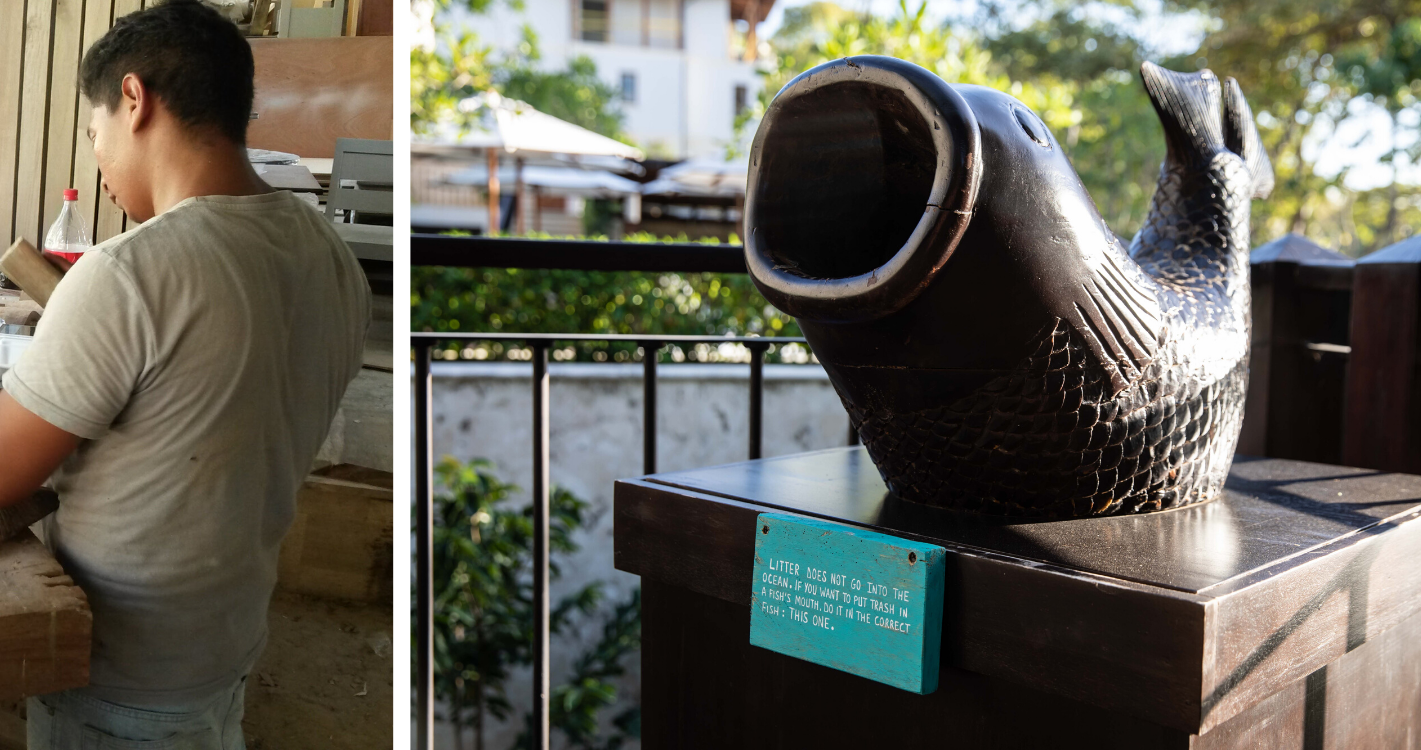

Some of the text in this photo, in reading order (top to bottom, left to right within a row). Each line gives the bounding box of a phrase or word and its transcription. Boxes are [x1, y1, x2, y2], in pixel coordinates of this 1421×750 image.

[762, 572, 908, 618] OCEAN. IF YOU WANT TO PUT TRASH IN
[769, 558, 909, 602] LITTER DOES NOT GO INTO THE
[761, 587, 766, 596] A
[769, 589, 791, 603] FISH'S
[824, 602, 833, 614] DO
[836, 605, 843, 616] IT
[845, 608, 853, 619] IN
[856, 611, 871, 624] THE
[875, 616, 911, 633] CORRECT
[789, 607, 808, 623] THIS
[813, 615, 834, 630] ONE.
